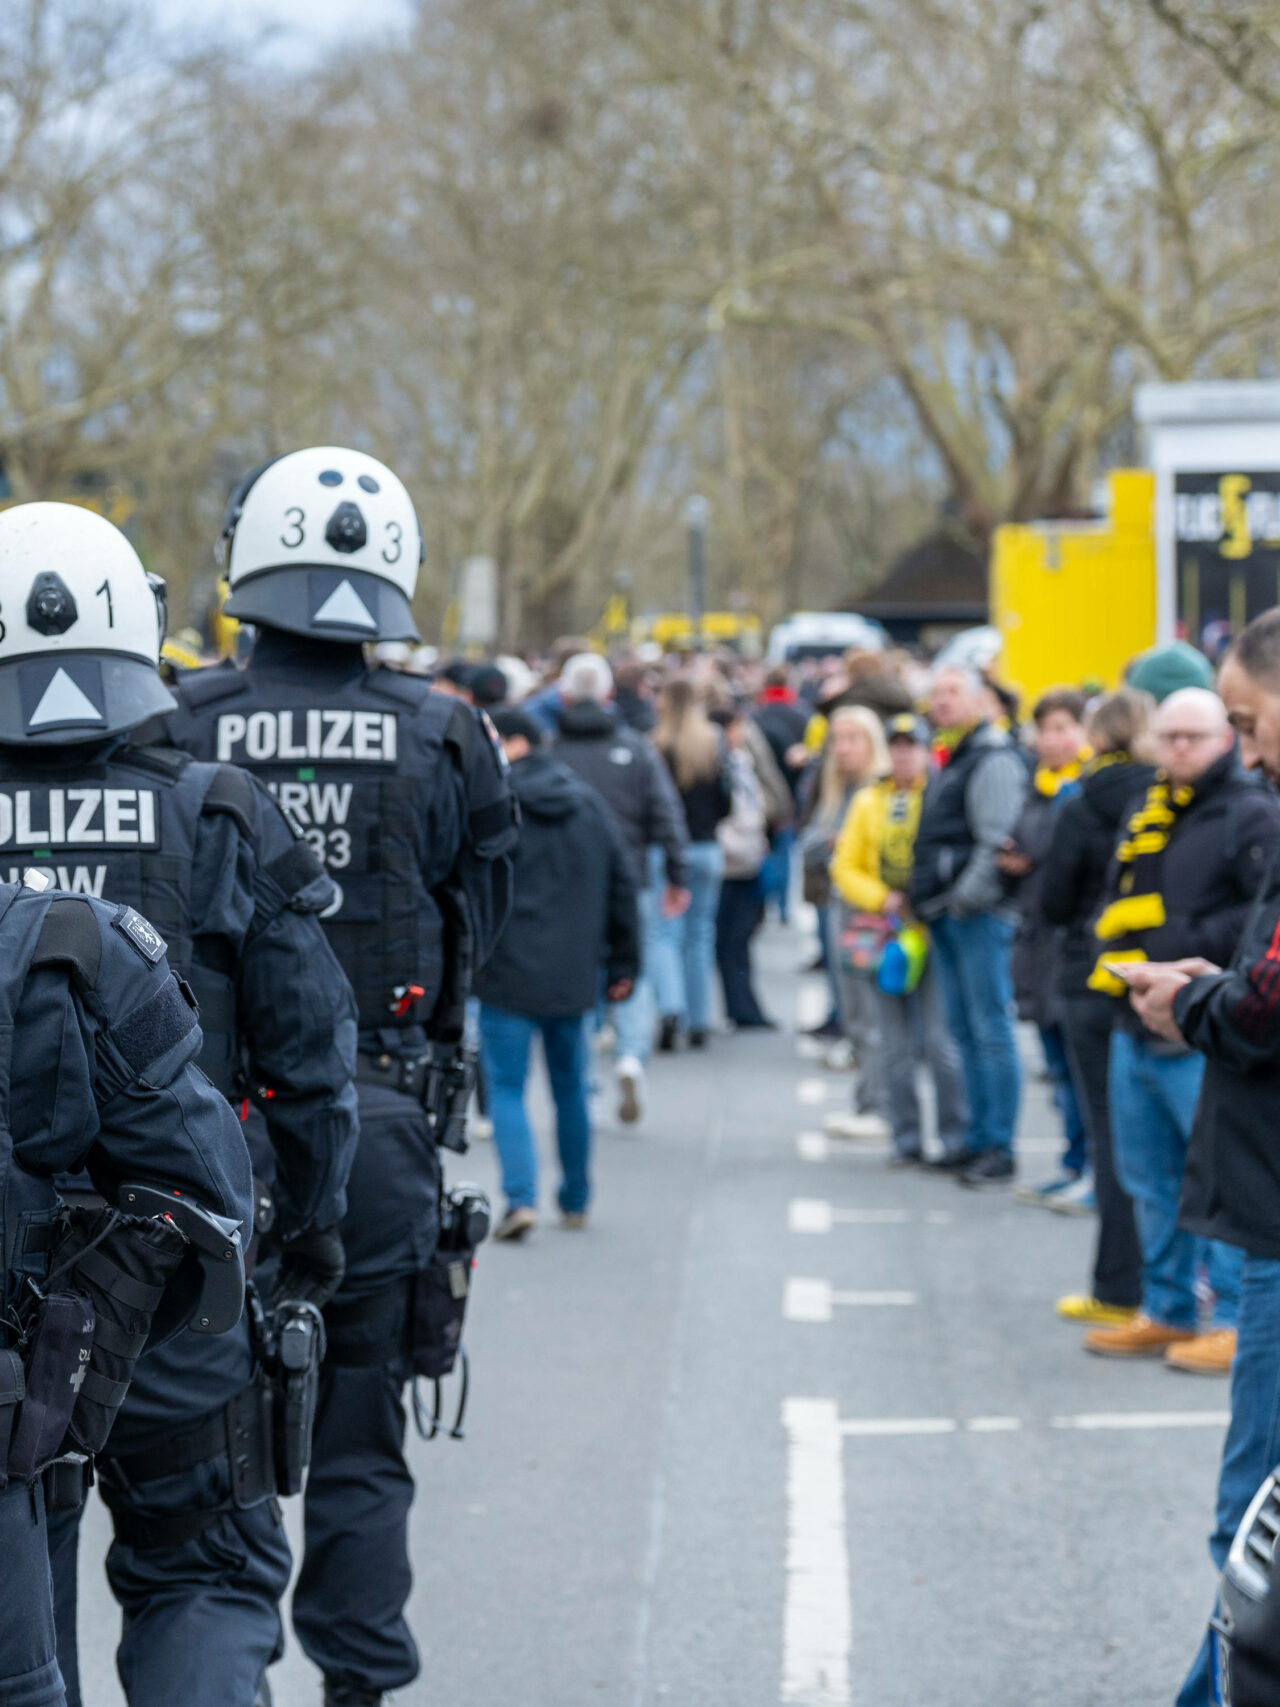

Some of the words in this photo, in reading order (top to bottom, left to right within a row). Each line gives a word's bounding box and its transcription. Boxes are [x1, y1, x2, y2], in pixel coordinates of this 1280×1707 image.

[281, 507, 305, 549] 3
[381, 522, 402, 565] 3
[96, 580, 114, 628] 1
[218, 710, 397, 761] POLIZEI
[267, 782, 353, 824] RW
[304, 828, 351, 868] 33
